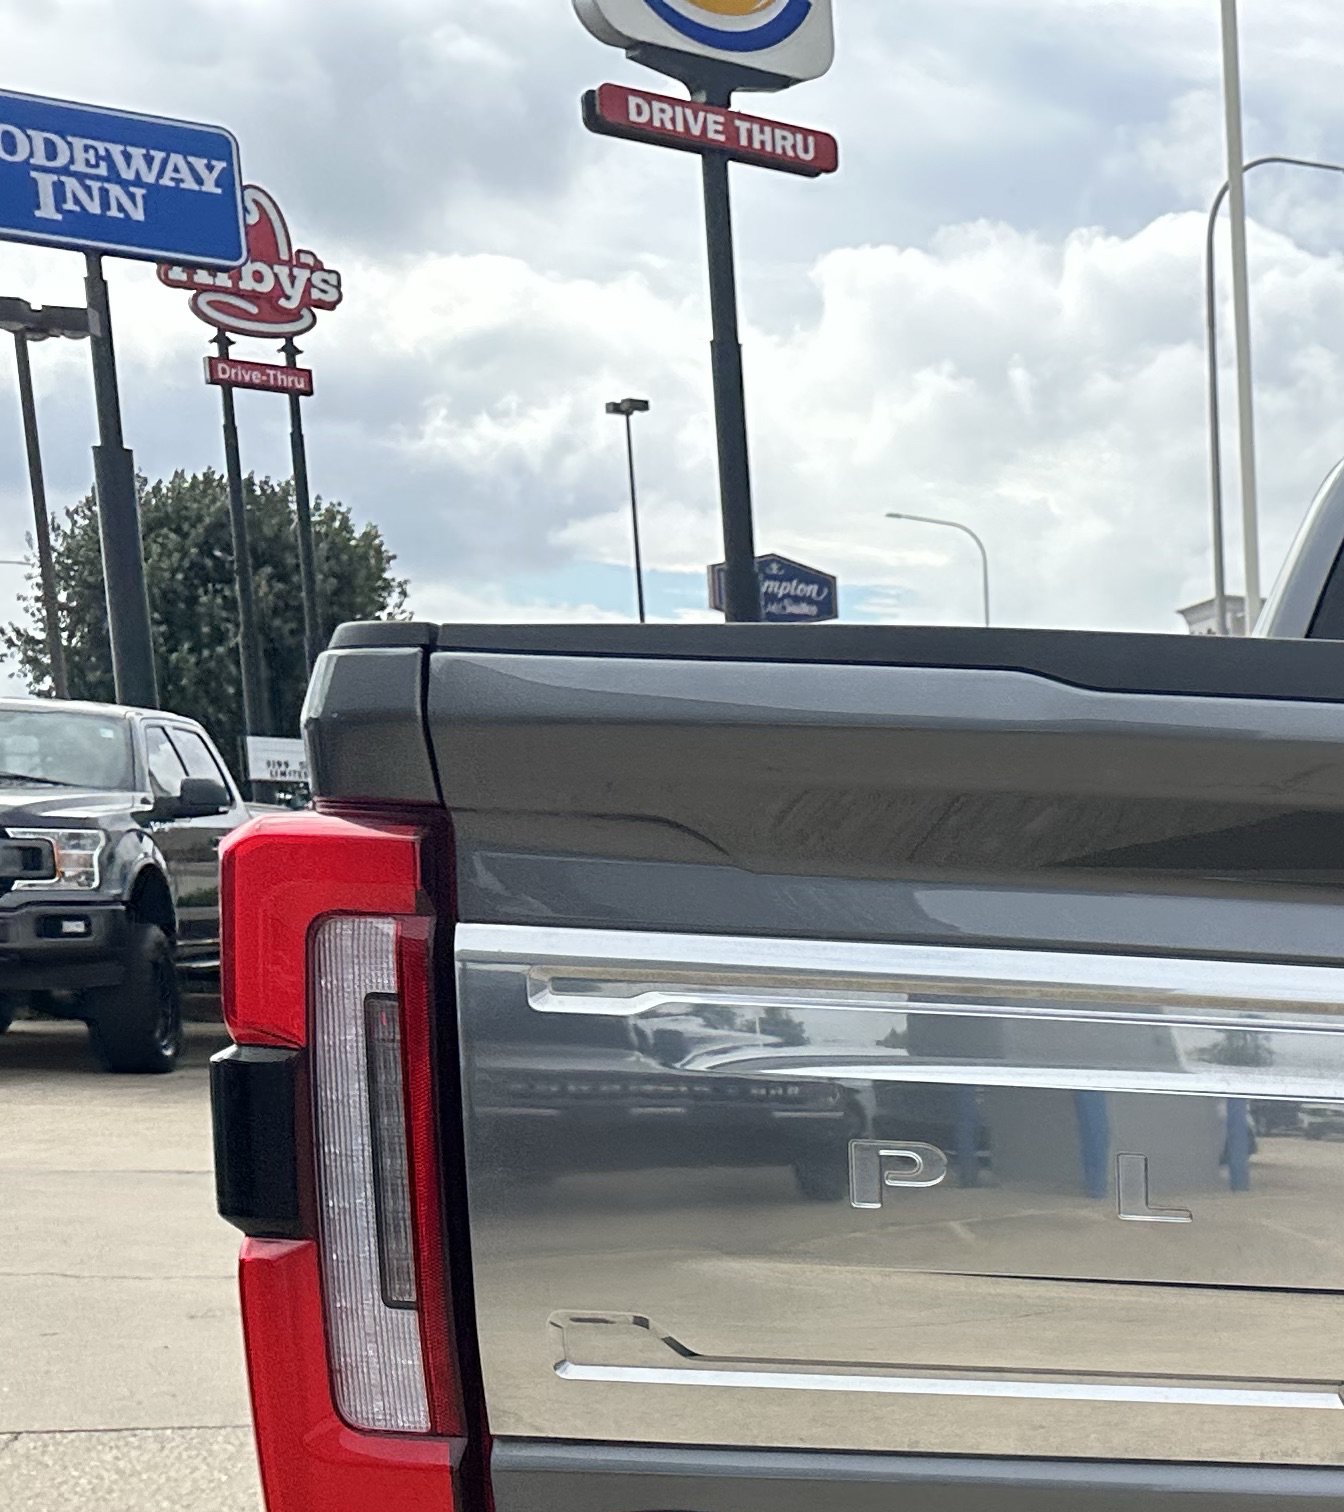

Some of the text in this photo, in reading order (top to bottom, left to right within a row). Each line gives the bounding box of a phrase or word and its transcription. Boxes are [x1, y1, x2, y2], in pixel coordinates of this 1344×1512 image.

[627, 95, 815, 161] DRIVE THRU
[30, 170, 147, 222] INN
[217, 362, 306, 389] Drive-Thru
[761, 577, 828, 601] mpton
